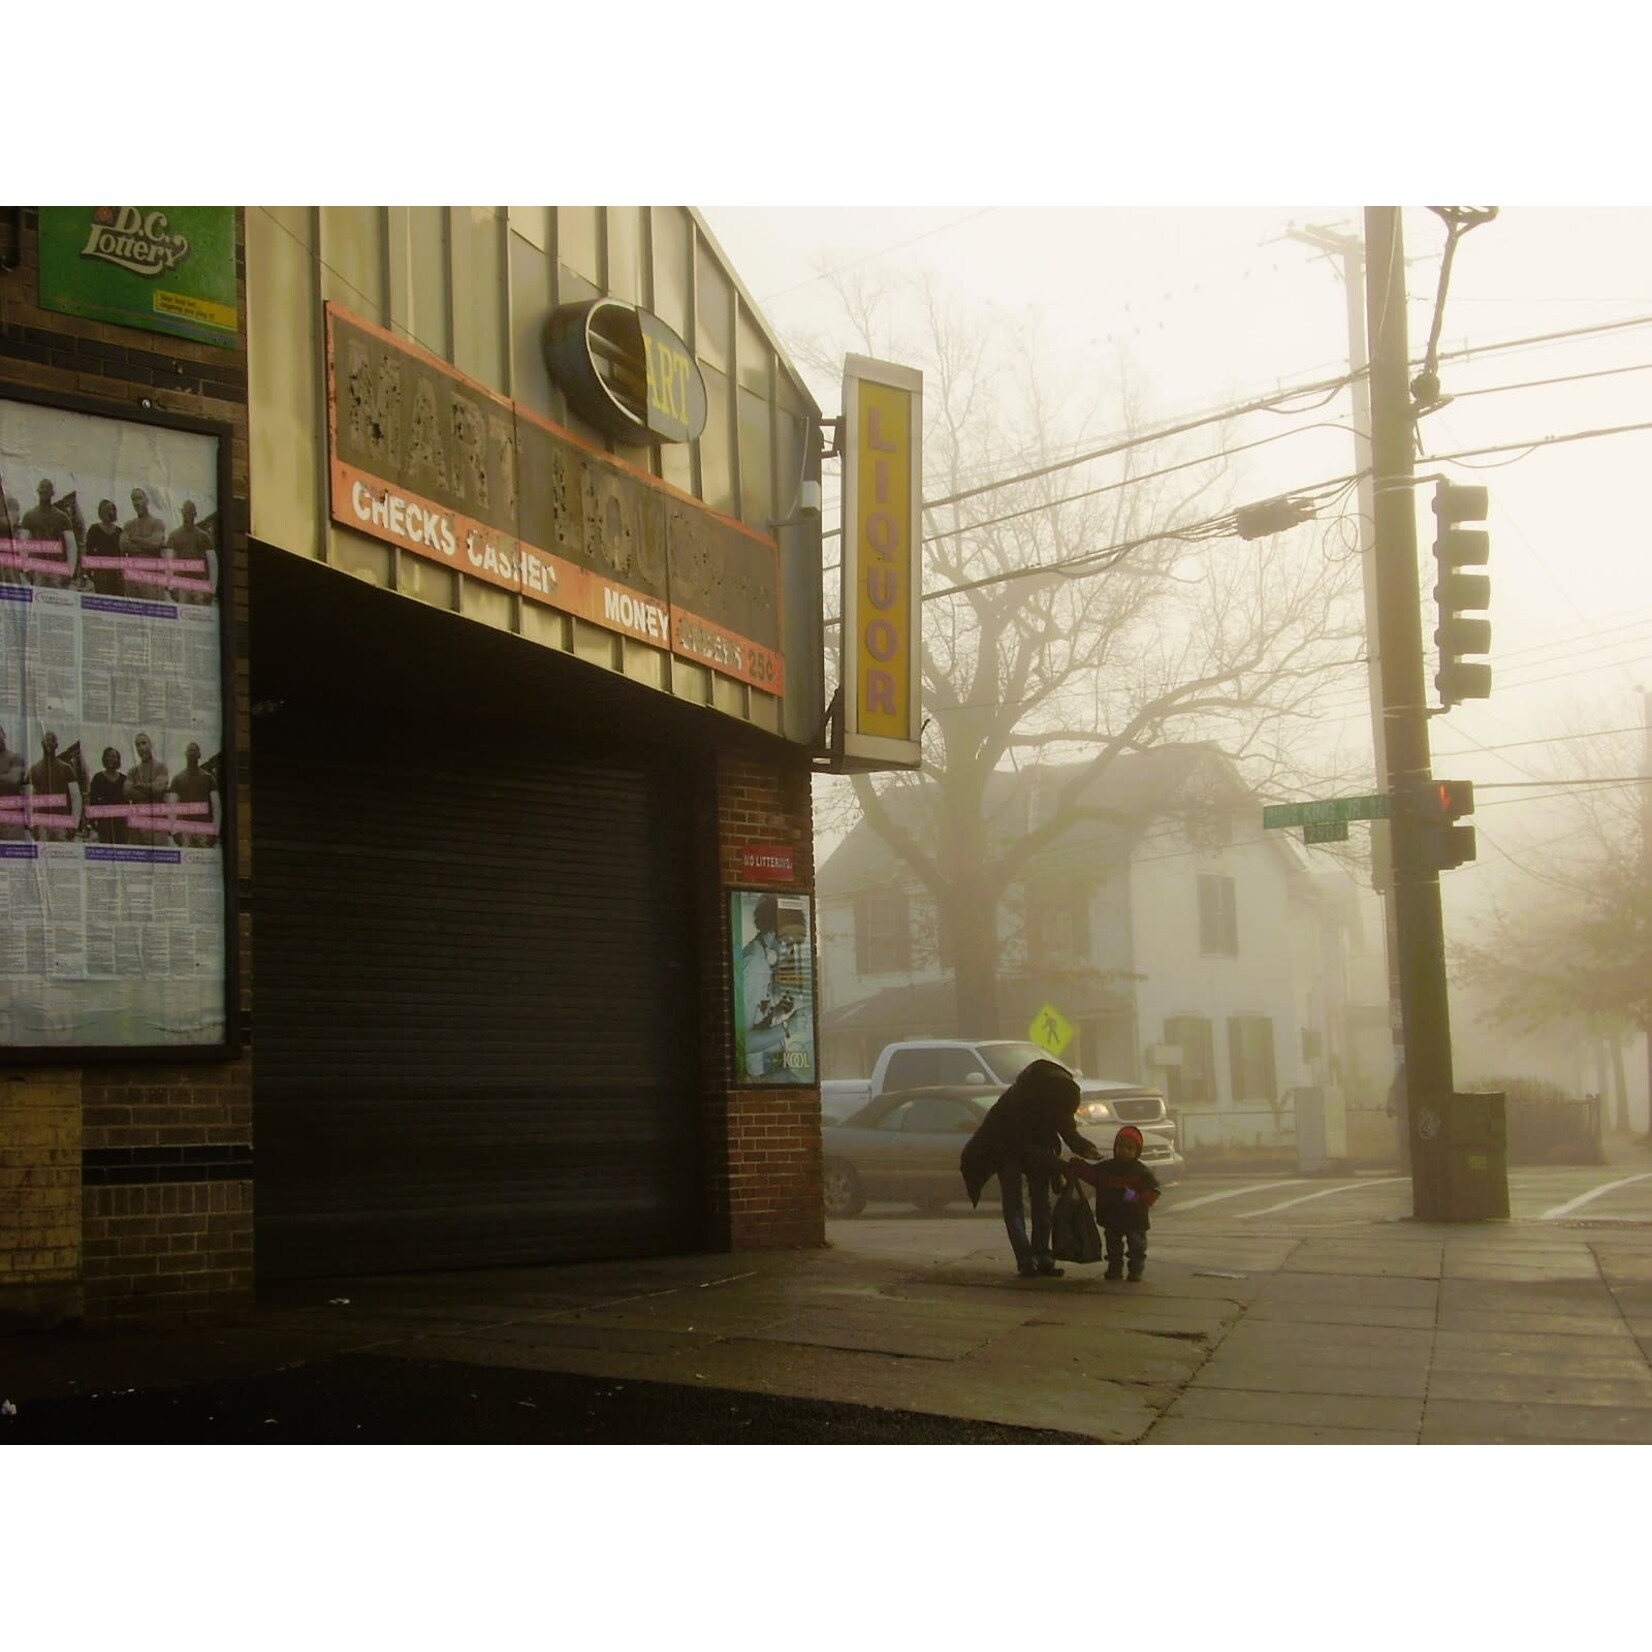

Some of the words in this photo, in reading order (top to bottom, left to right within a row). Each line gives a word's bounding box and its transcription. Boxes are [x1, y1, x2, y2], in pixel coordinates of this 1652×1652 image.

[81, 223, 188, 270] Lottery
[352, 480, 456, 556] CHECKS
[603, 586, 670, 641] MONEY
[865, 403, 899, 717] LIQUOR
[744, 855, 755, 867] NO
[783, 1052, 811, 1069] KOOL
